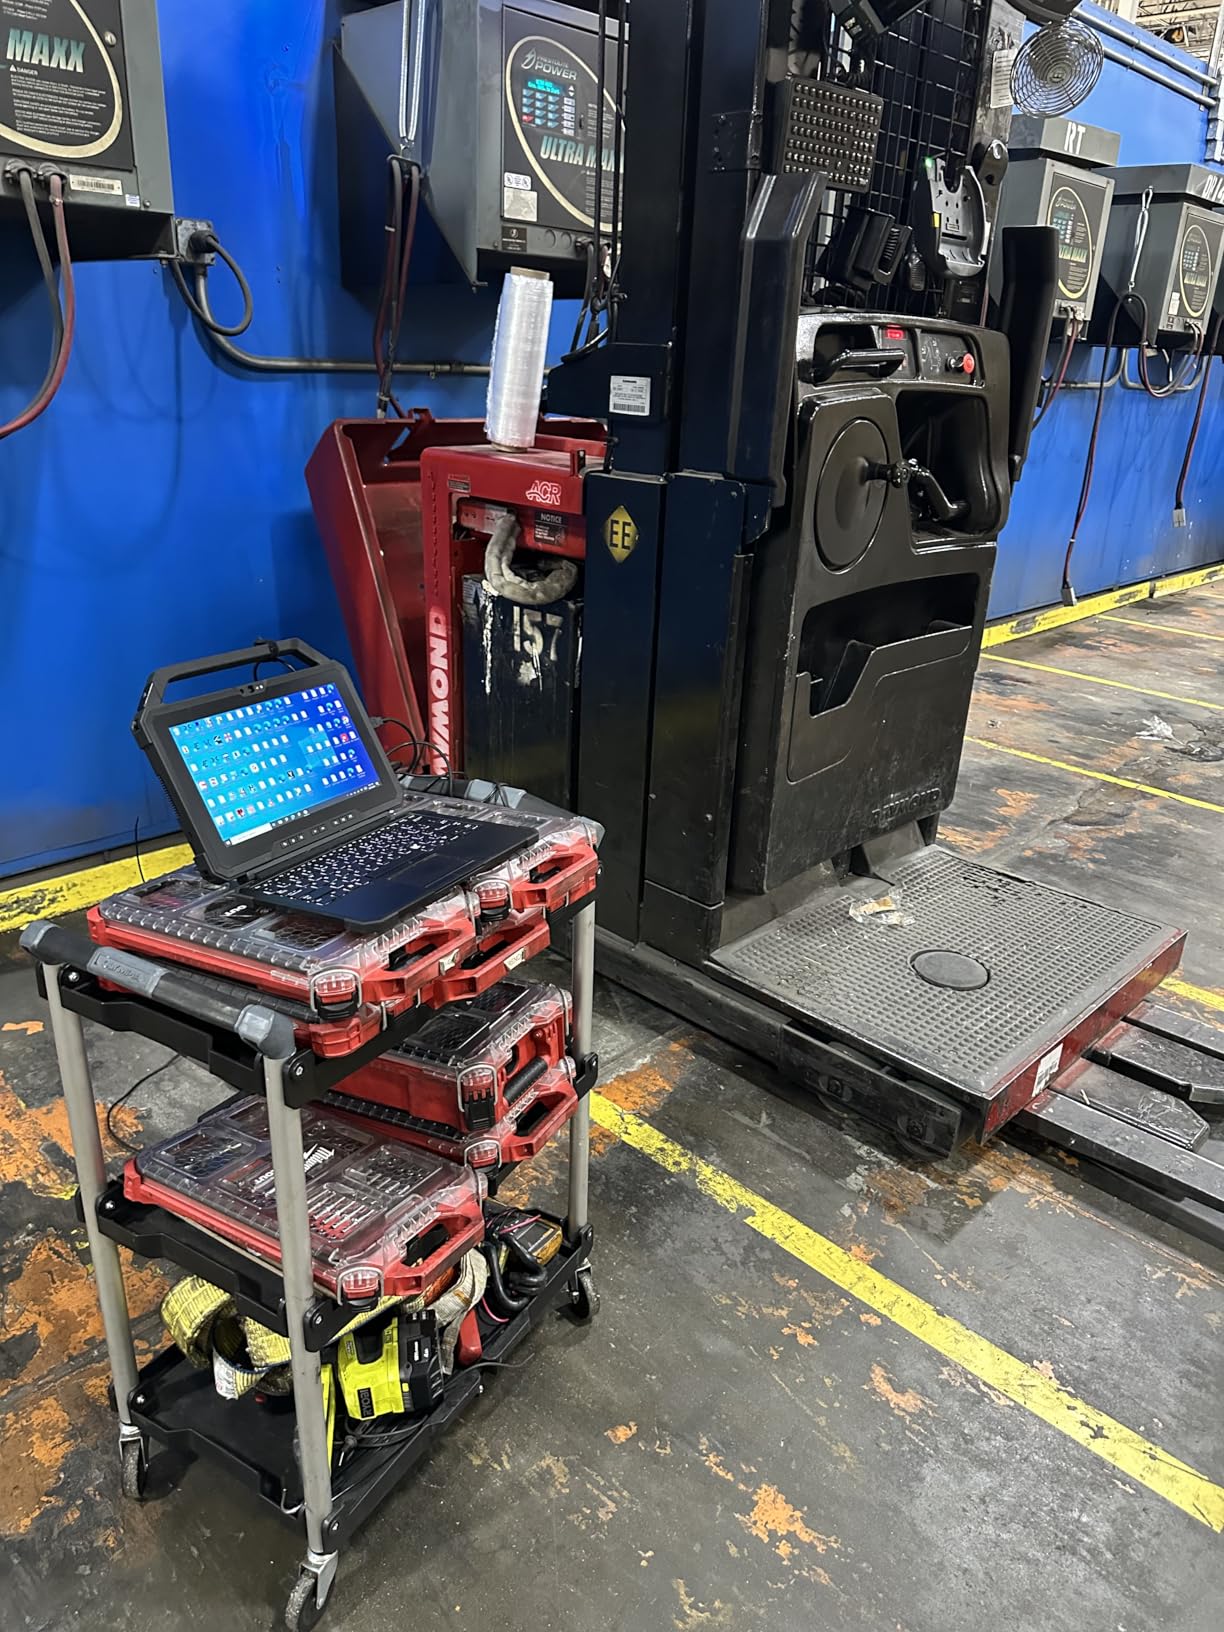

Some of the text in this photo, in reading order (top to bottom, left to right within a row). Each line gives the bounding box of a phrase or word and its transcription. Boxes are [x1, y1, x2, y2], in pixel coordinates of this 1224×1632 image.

[7, 28, 85, 73] MAXX
[535, 61, 577, 80] POWER
[540, 135, 585, 166] ULTRA
[1064, 122, 1086, 155] RT
[525, 480, 562, 505] ACR
[540, 513, 562, 524] NOTICE
[609, 519, 631, 550] EE
[513, 606, 563, 661] 157
[359, 1388, 373, 1418] RYOBI
